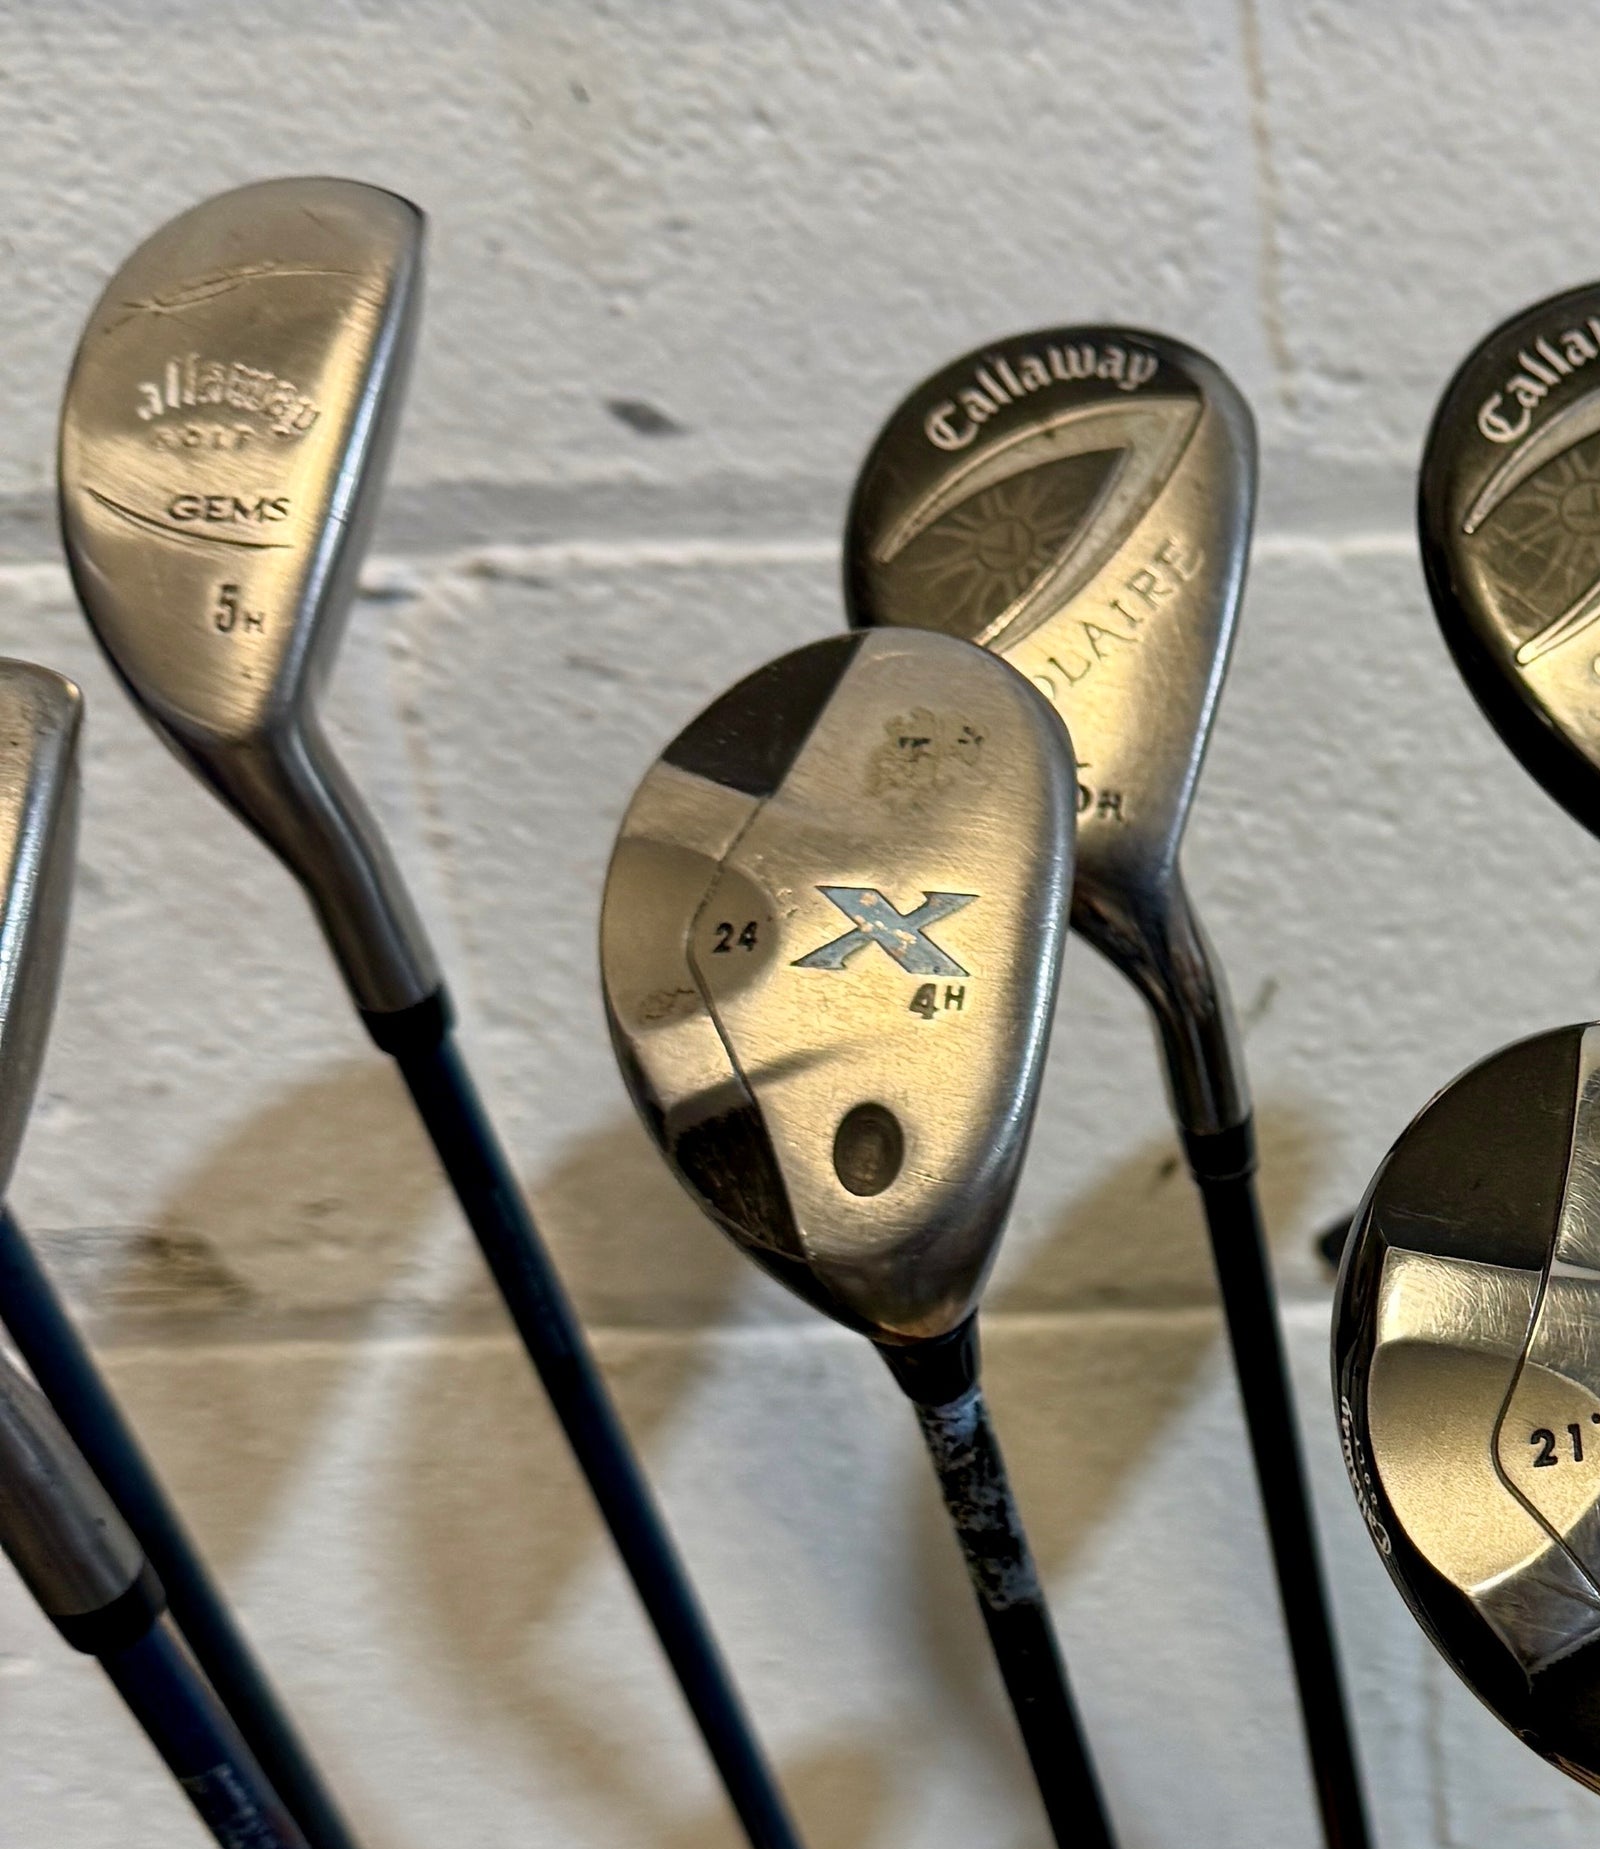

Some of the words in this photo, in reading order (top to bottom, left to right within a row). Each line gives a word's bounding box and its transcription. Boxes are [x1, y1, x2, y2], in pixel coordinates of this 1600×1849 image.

[137, 353, 320, 437] allaway
[924, 344, 1159, 450] Callaway
[167, 494, 291, 521] GEMS
[213, 584, 264, 634] 5H
[1033, 537, 1205, 701] LAIRE
[790, 885, 981, 977] X
[909, 982, 967, 1020] 4H
